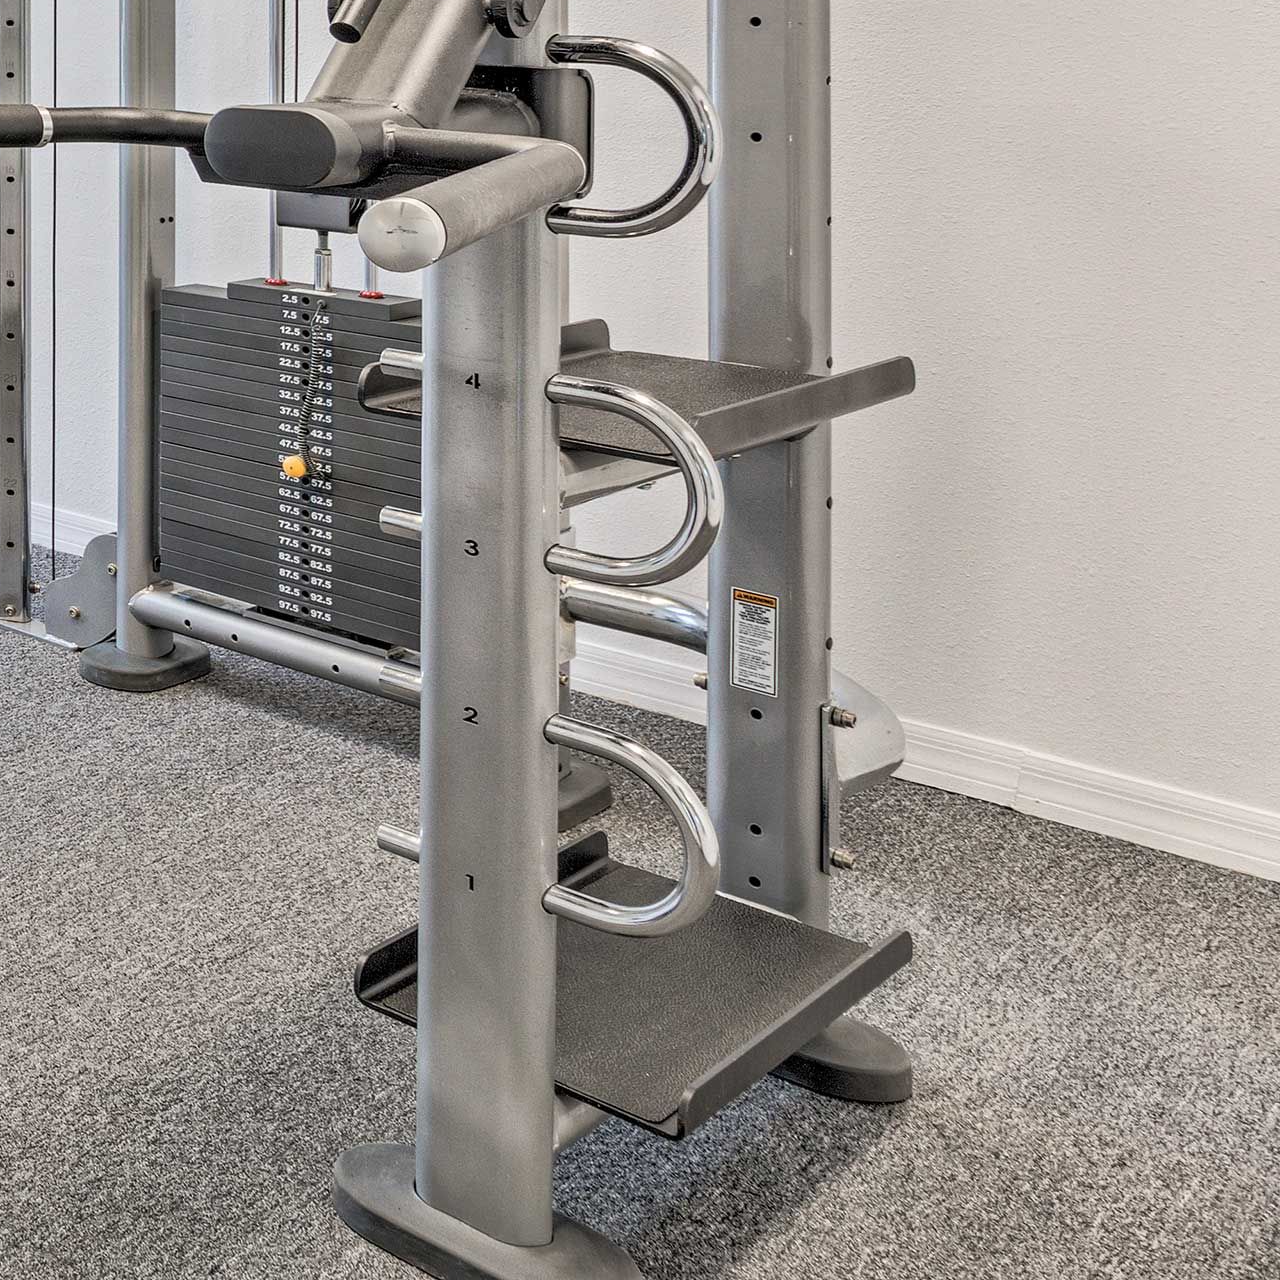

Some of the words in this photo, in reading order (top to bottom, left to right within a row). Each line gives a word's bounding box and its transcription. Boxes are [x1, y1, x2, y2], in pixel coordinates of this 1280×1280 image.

[282, 295, 298, 304] 2.5
[282, 310, 297, 319] 7.5
[280, 326, 300, 336] 12.5
[280, 342, 300, 352] 17.5
[279, 358, 301, 368] 22.5
[315, 364, 333, 374] 2.5
[280, 374, 300, 385] 27.5
[465, 373, 481, 390] 4
[315, 381, 332, 391] 7.5
[279, 390, 300, 401] 32.5
[280, 406, 300, 417] 37.5
[311, 413, 332, 424] 37.5
[279, 423, 300, 434] 42.5
[310, 430, 333, 440] 42.5
[280, 439, 300, 450] 47.5
[311, 446, 332, 457] 47.5
[314, 462, 331, 473] 2.5
[311, 479, 332, 490] 57.5
[279, 488, 300, 499] 62.5
[310, 496, 333, 507] 62.5
[280, 504, 300, 515] 67.5
[311, 512, 332, 523] 67.5
[278, 520, 300, 532] 72.5
[310, 527, 332, 540] 72.5
[279, 536, 299, 548] 77.5
[310, 544, 331, 556] 77.5
[464, 540, 480, 557] 3
[279, 552, 300, 564] 82.5
[310, 560, 332, 573] 82.5
[279, 568, 299, 580] 87.5
[311, 577, 331, 589] 87.5
[279, 584, 300, 596] 92.5
[310, 593, 333, 605] 92.5
[279, 600, 299, 612] 97.5
[311, 609, 331, 622] 97.5
[462, 706, 479, 725] 2
[465, 874, 475, 892] 1
